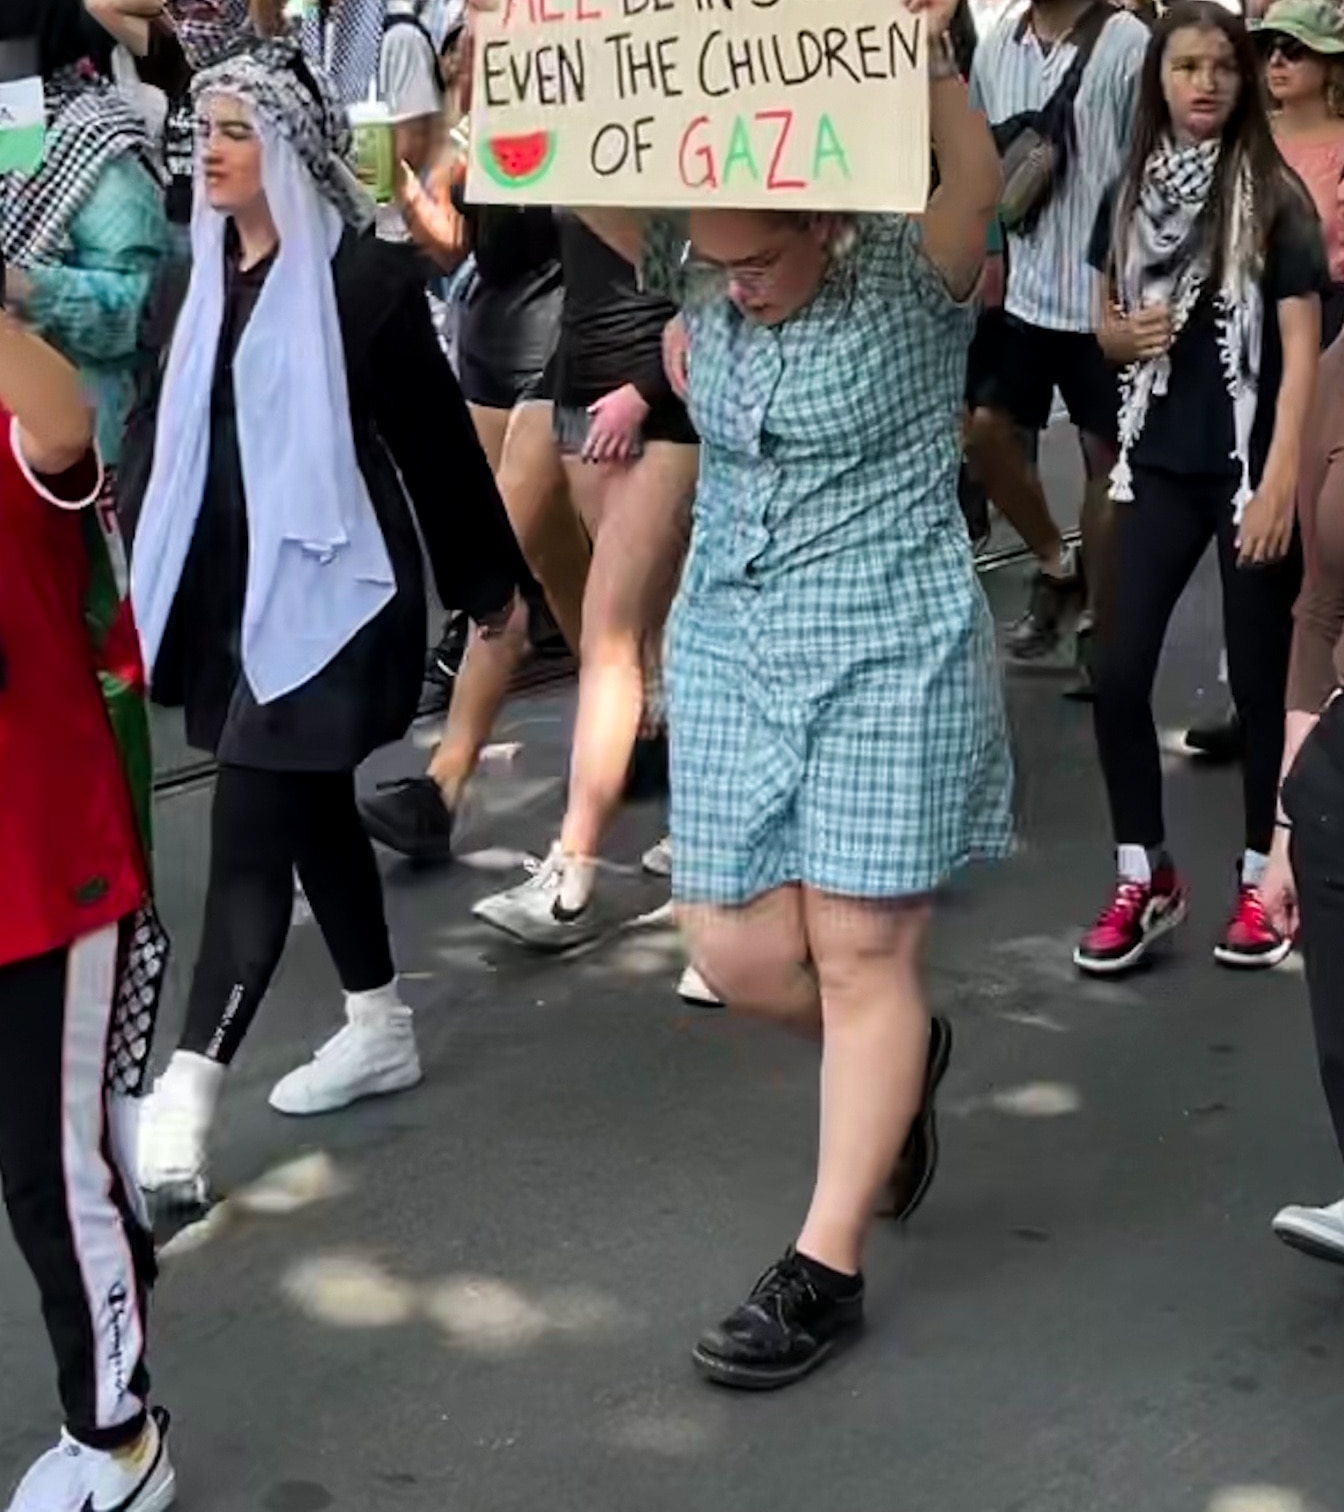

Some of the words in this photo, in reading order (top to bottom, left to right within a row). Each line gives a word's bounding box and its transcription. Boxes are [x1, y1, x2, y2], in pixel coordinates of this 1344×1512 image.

[483, 40, 584, 106] EVEN
[605, 31, 683, 100] THE
[698, 19, 921, 97] CHILDREN
[590, 116, 654, 176] OF
[678, 110, 851, 190] GAZA
